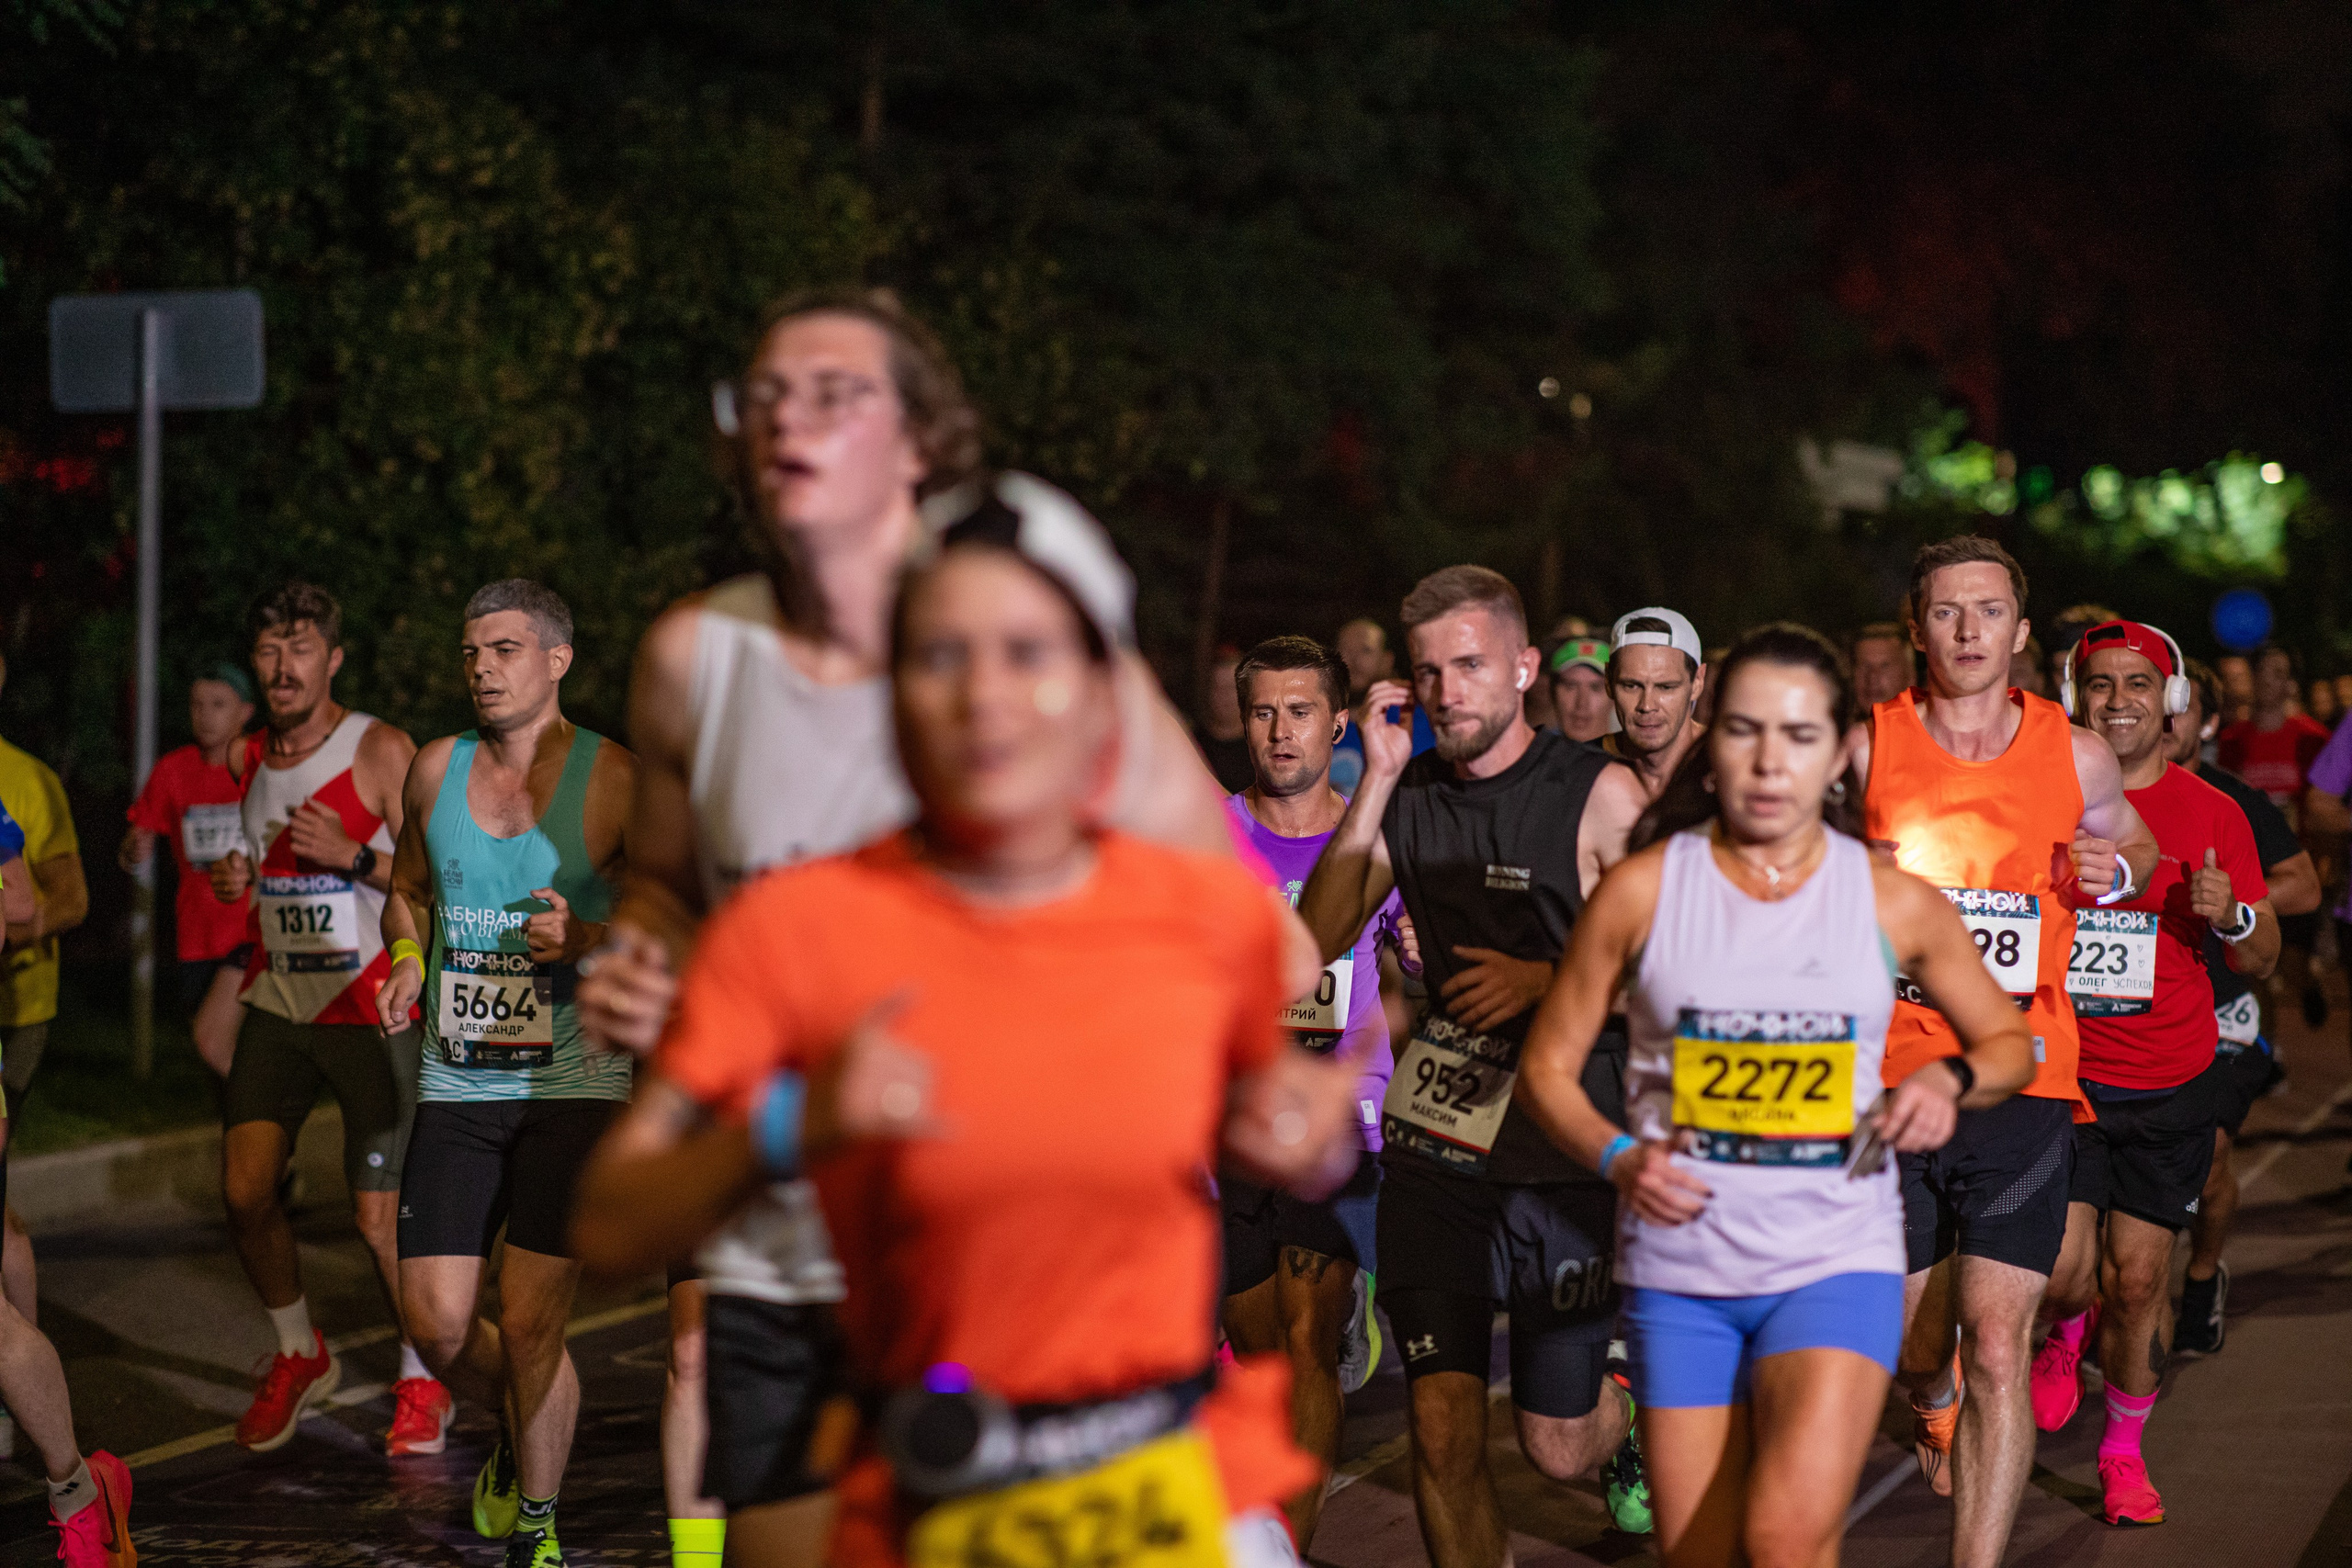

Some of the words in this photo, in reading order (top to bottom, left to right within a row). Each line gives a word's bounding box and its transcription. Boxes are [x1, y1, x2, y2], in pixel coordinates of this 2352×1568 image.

[277, 904, 334, 933] 1312
[2068, 941, 2129, 975] 223
[2078, 976, 2108, 987] ОЛЕГ
[2113, 977, 2153, 991] УСПЕХОВ
[452, 983, 537, 1021] 5664
[458, 1022, 525, 1037] АЛЕКСАНДР
[1414, 1057, 1481, 1116] 952
[1702, 1055, 1832, 1101] 2272
[1410, 1102, 1459, 1128] МАКСИМ
